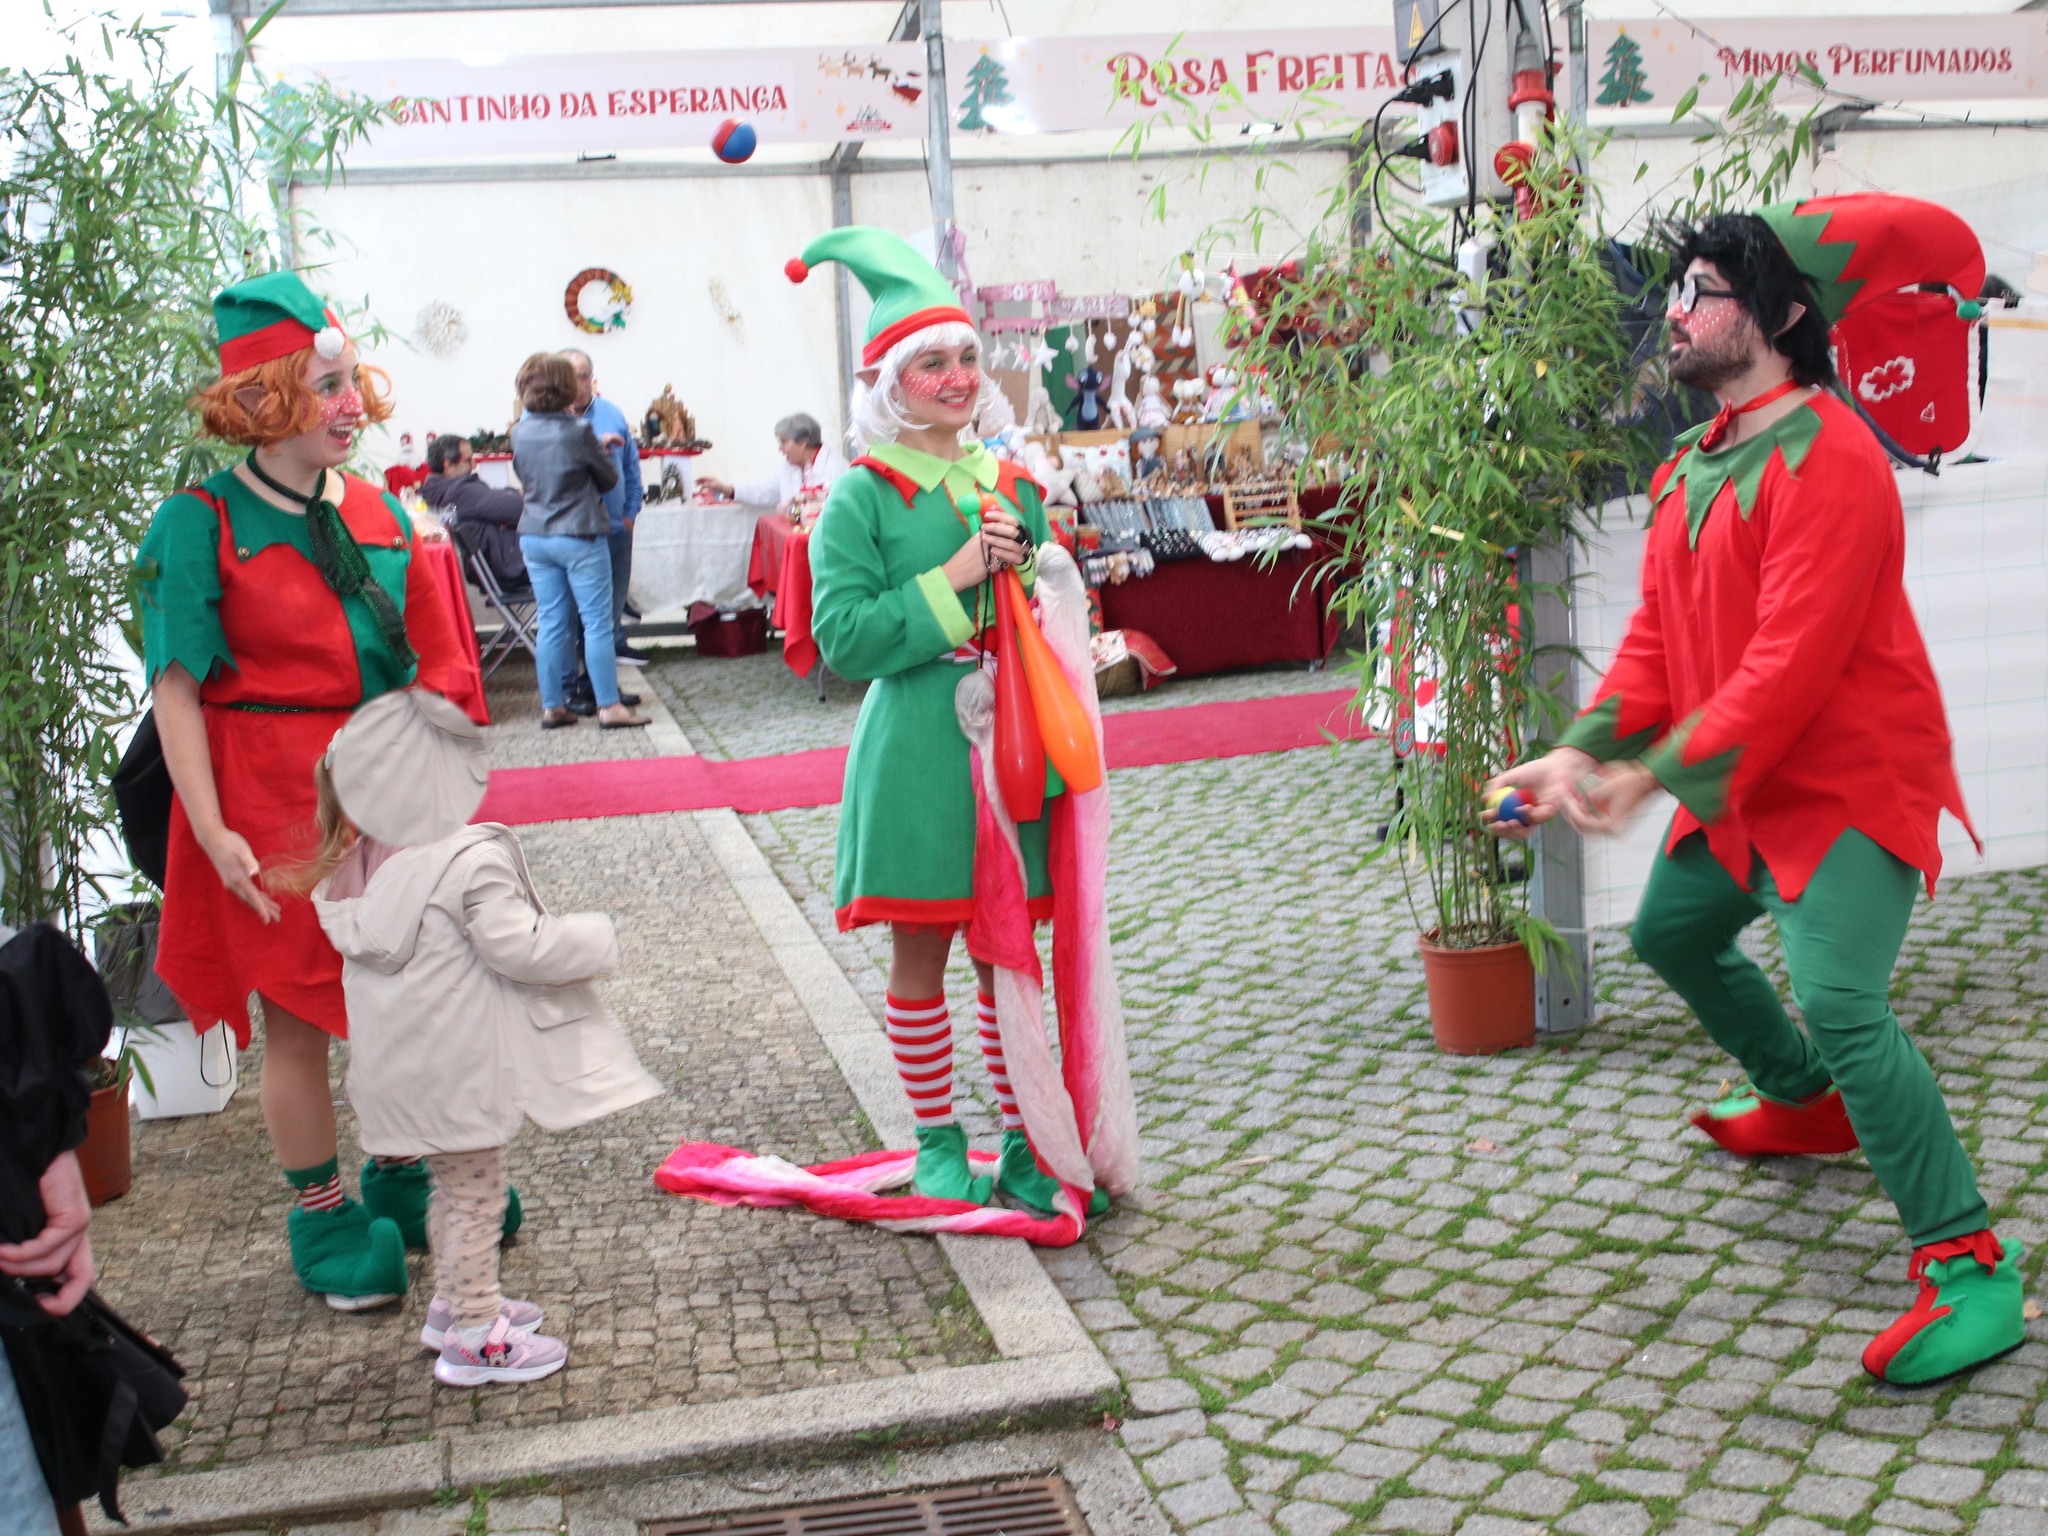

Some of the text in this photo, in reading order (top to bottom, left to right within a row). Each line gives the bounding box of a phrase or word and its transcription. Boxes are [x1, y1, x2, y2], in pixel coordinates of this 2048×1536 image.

[1717, 43, 2013, 78] MIMOS PERFUMADOS
[1106, 51, 1229, 107] ROSA
[560, 91, 597, 119] DA
[607, 84, 788, 117] ESPERANÇA
